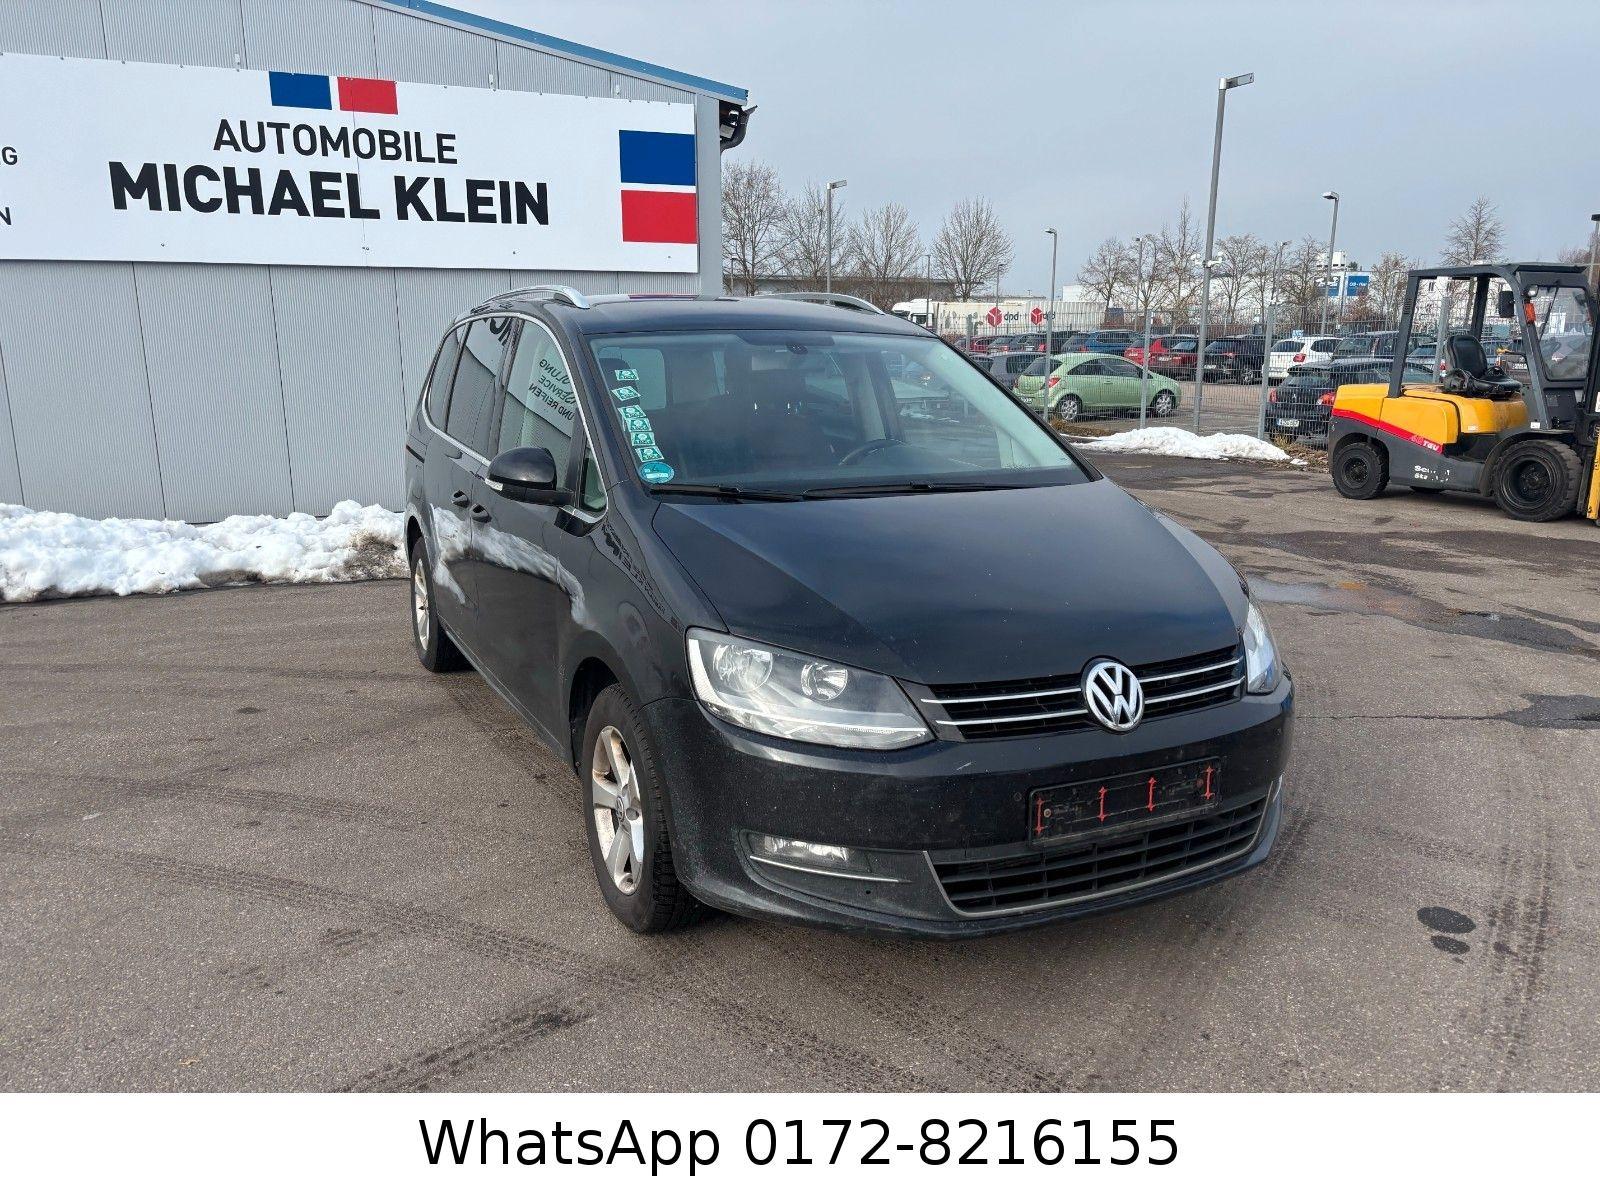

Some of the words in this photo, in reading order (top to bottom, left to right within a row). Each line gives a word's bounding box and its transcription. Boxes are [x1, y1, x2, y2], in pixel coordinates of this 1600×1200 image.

[214, 119, 457, 164] AUTOMOBILE
[109, 162, 380, 219] MICHAEL
[394, 176, 548, 225] KLEIN
[1004, 312, 1019, 323] dpd
